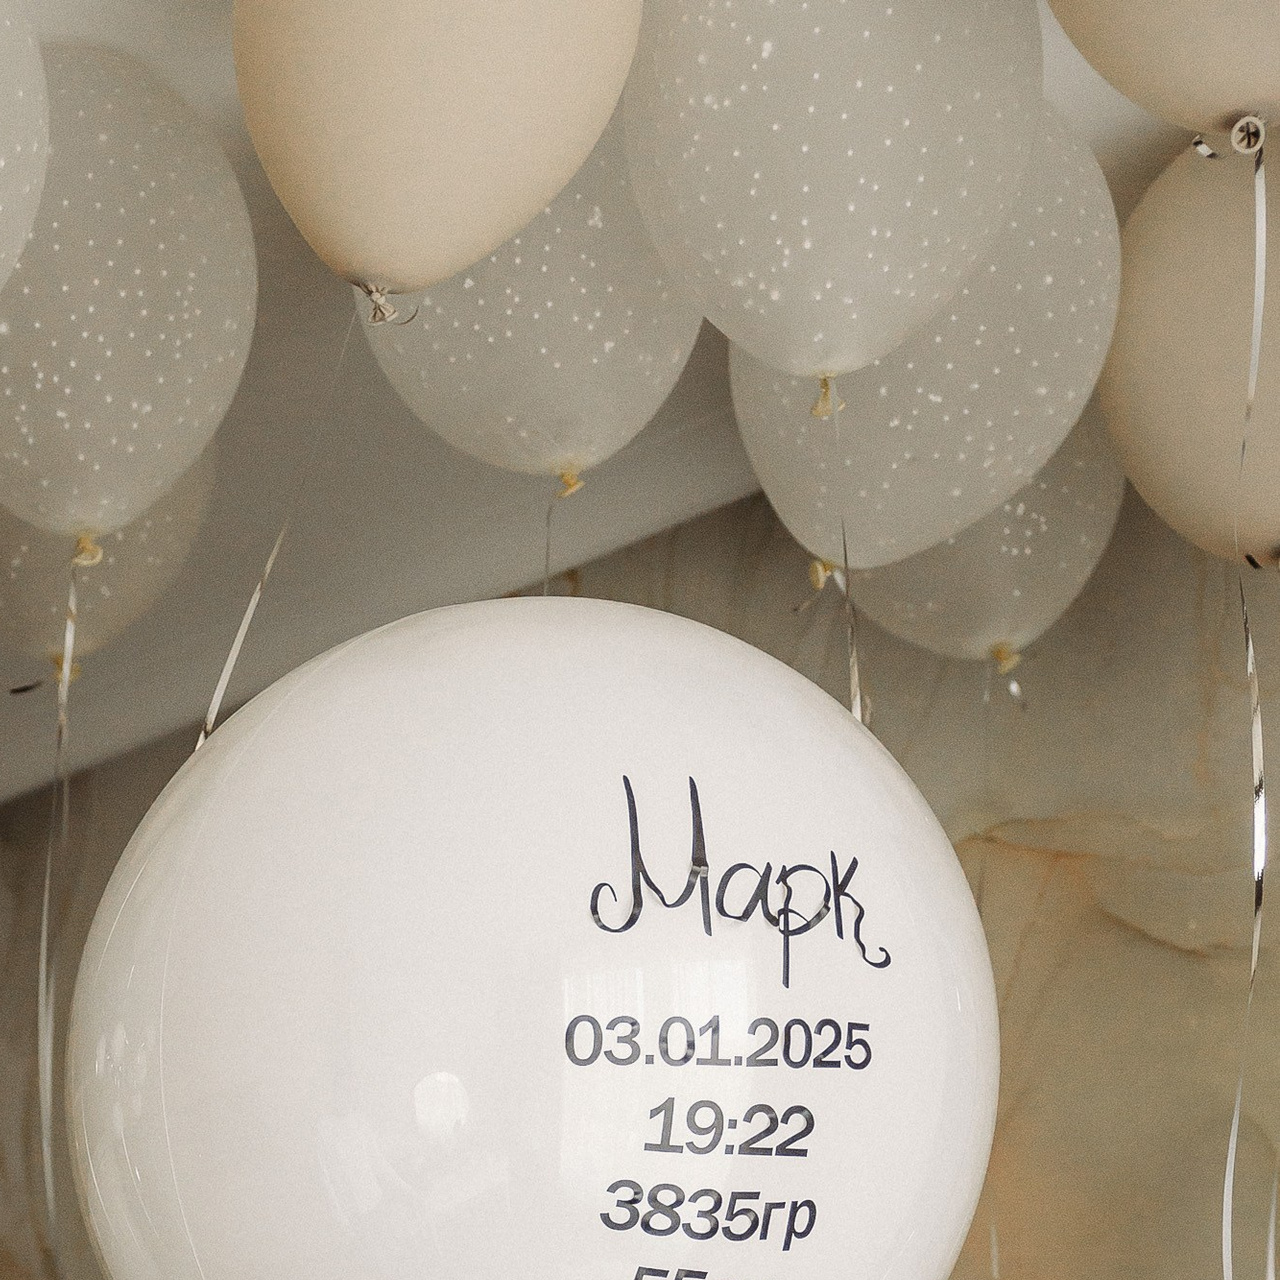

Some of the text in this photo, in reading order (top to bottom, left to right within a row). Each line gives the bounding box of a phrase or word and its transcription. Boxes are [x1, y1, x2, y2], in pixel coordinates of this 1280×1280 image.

[590, 774, 891, 988] Марк
[565, 1014, 872, 1070] 03.01.2025
[643, 1097, 815, 1157] 19:22
[600, 1179, 817, 1251] 3835гр
